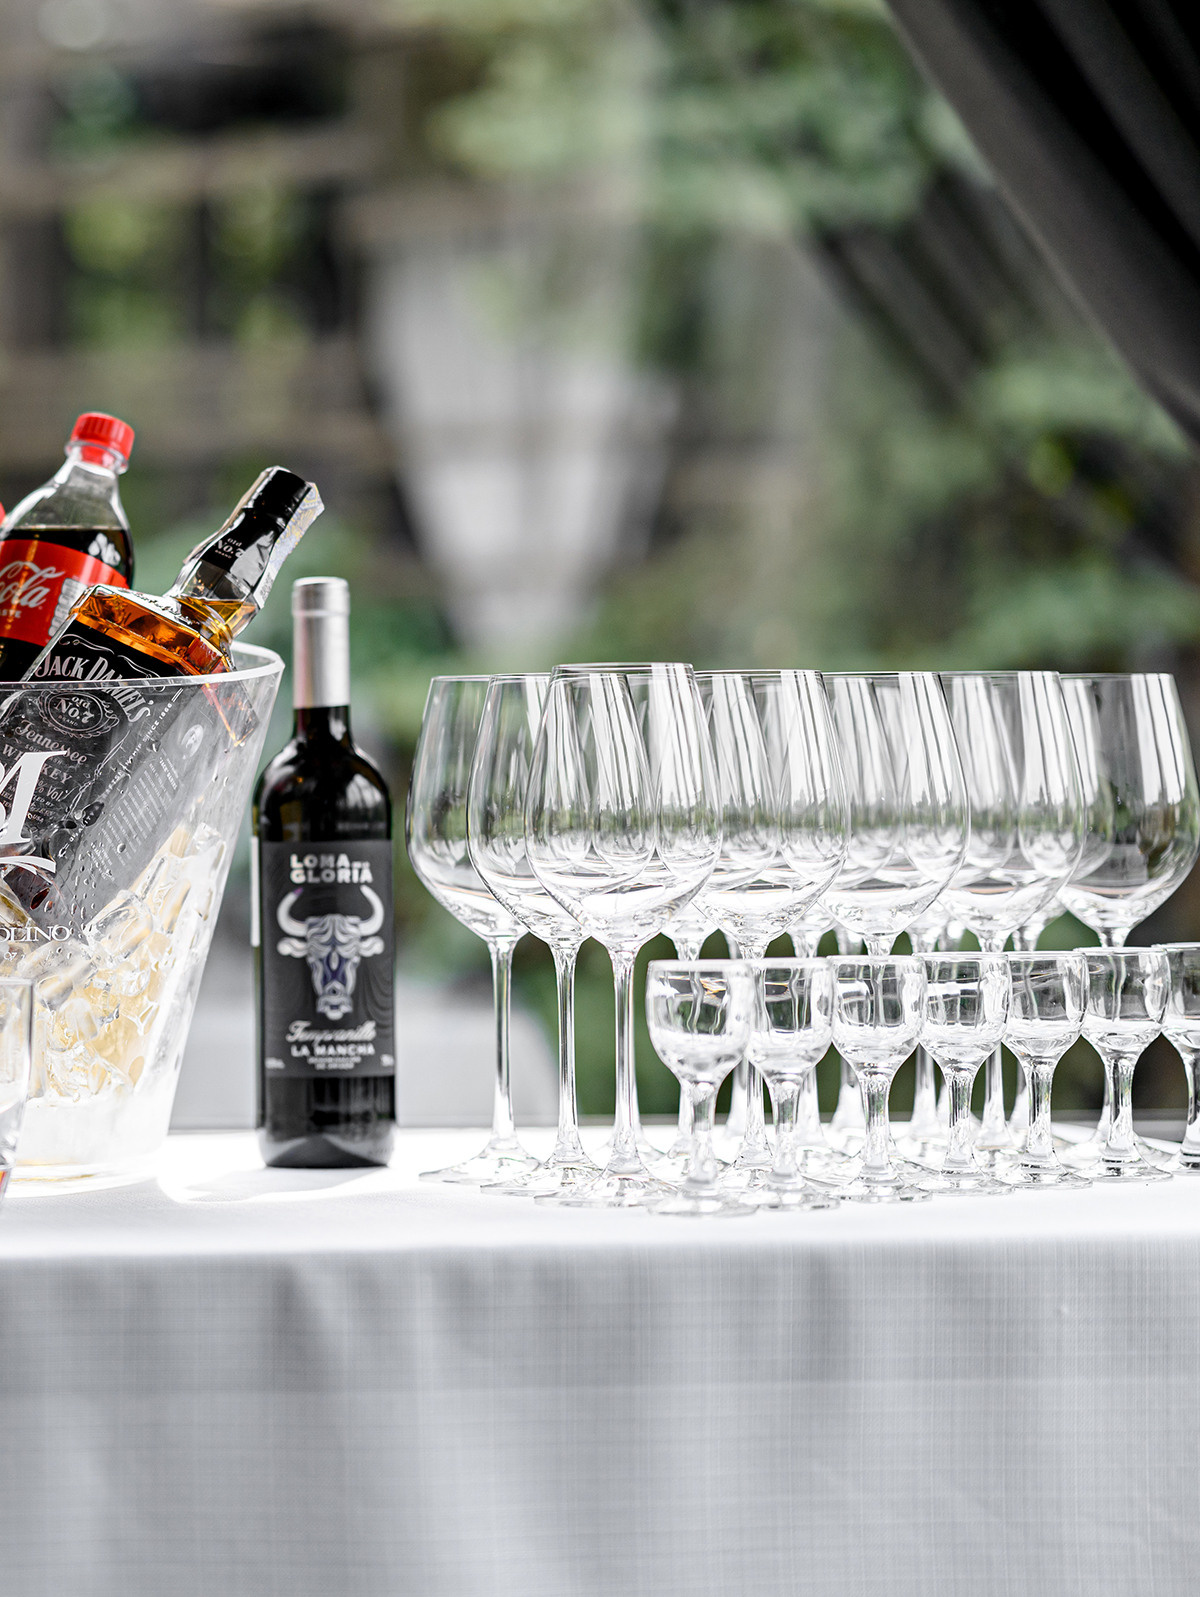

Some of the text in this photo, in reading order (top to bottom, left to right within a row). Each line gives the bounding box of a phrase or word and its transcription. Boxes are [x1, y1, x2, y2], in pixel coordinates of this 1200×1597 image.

[34, 650, 90, 680] JACK
[14, 719, 88, 763] Tennessee
[289, 868, 374, 884] GLORIA
